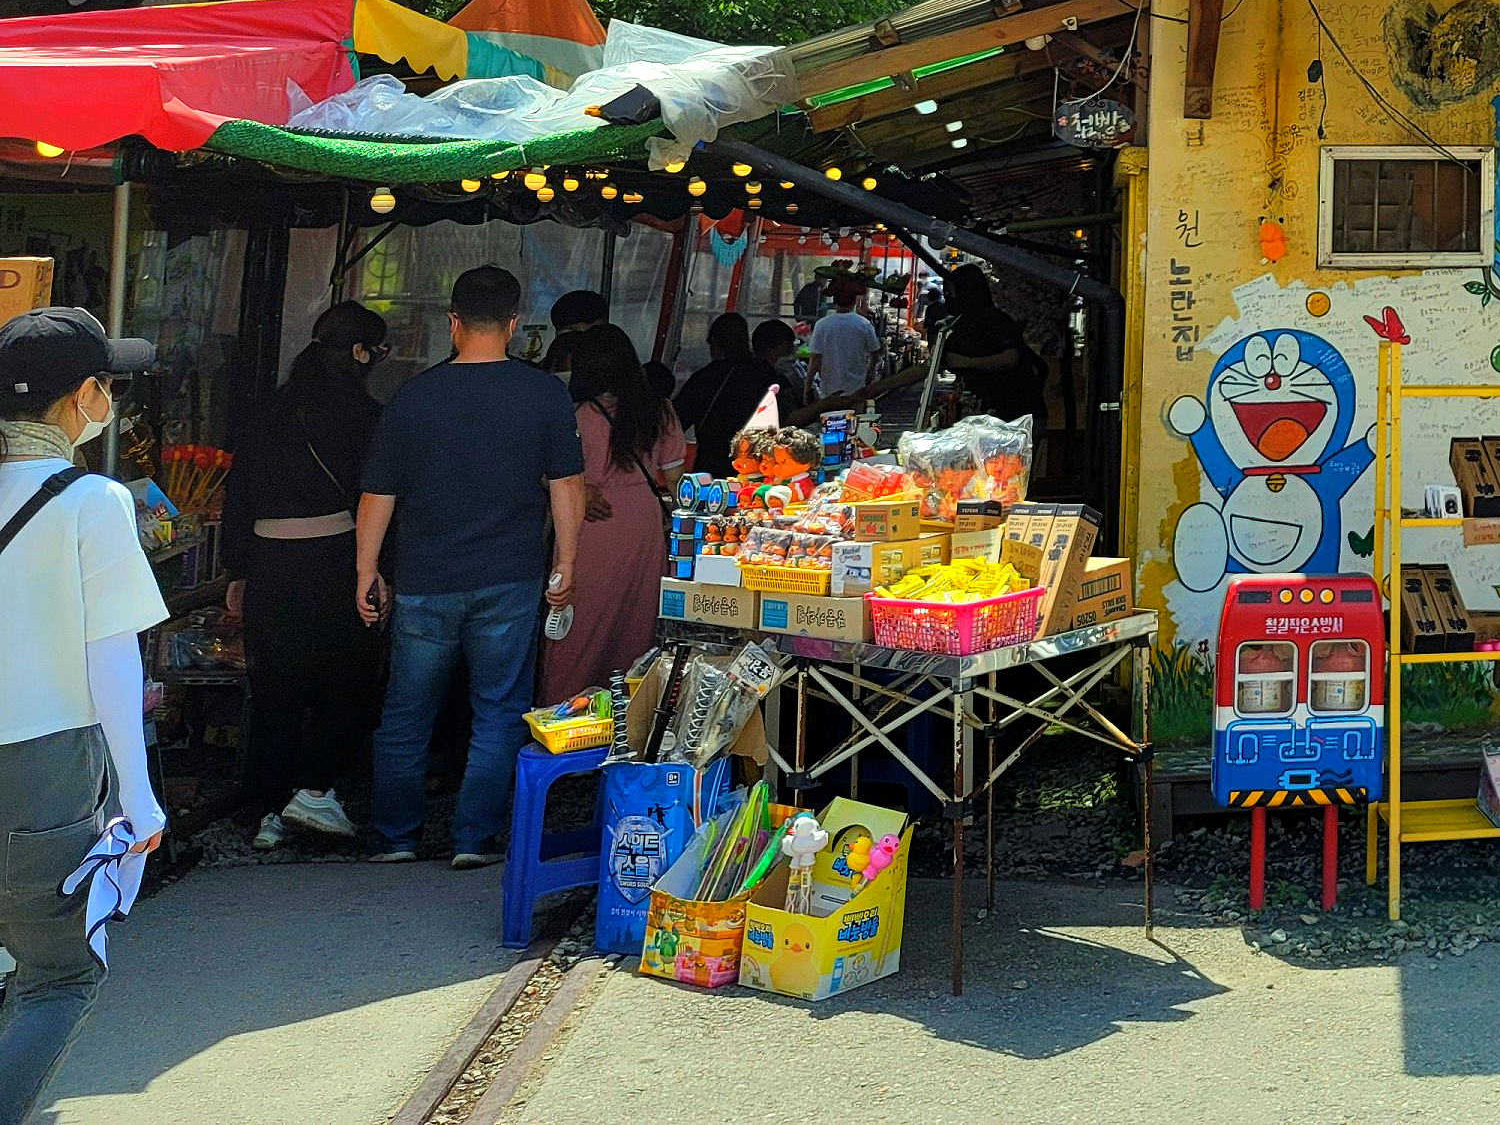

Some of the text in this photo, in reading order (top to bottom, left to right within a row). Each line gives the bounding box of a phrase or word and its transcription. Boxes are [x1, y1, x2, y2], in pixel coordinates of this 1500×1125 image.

[1168, 257, 1200, 362] 노란집
[1265, 617, 1344, 635] 철길작은소방서
[616, 832, 660, 856] 스워드
[620, 855, 650, 877] 소울
[747, 929, 775, 950] 비눗방울
[837, 914, 880, 942] 비눗방울
